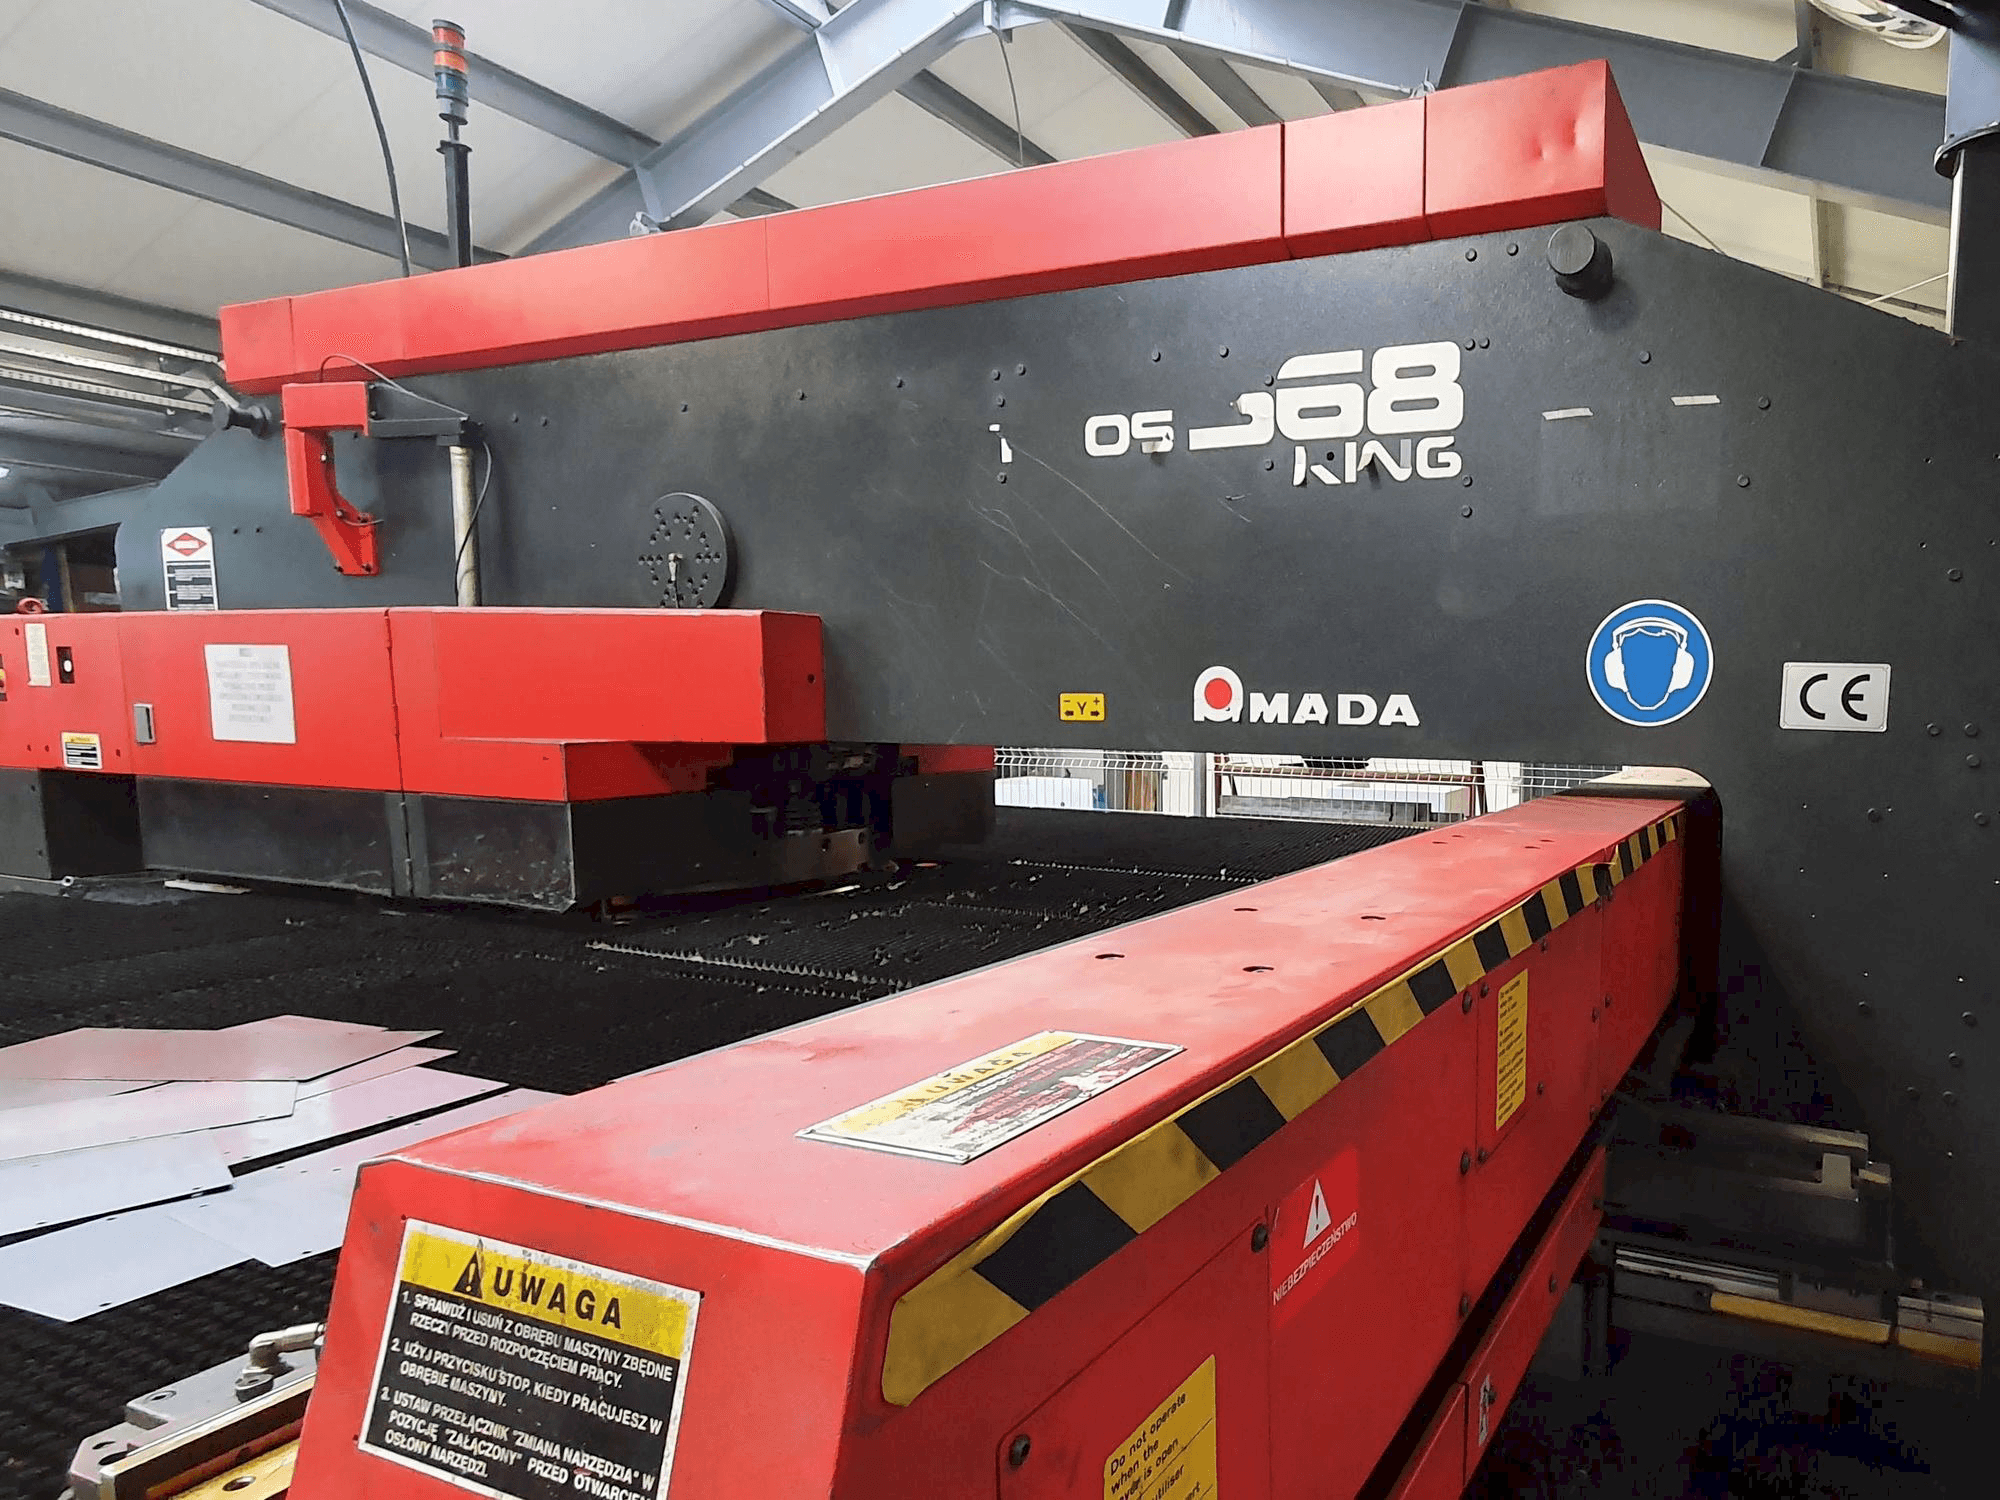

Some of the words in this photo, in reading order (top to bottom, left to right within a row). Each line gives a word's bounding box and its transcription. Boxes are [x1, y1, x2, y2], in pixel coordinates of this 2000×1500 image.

[1799, 673, 1871, 722] CE
[1272, 1211, 1358, 1306] NIEBEZPIECZEŃSTWO
[493, 1265, 622, 1330] UWAGA
[410, 1312, 453, 1336] RZECZY
[452, 1324, 489, 1348] PRZED
[489, 1336, 578, 1375] ROZPOCZĘCIEM
[579, 1361, 623, 1389] PRACY.
[472, 1309, 505, 1331] USUŃ
[504, 1319, 514, 1335] Z
[514, 1322, 563, 1348] OBRĘBU
[563, 1336, 622, 1366] MASZYNY
[622, 1353, 674, 1382] ZBĘDNE
[400, 1360, 450, 1388] OBRĘBIE
[449, 1377, 507, 1407] MASZYNY.
[403, 1341, 433, 1362] UŻYJ
[432, 1350, 498, 1382] PRZYCISKU
[497, 1369, 532, 1396] STOP,
[532, 1381, 571, 1405] KIEDY
[571, 1394, 648, 1431] PRACUJESZ
[649, 1417, 663, 1435] W
[384, 1429, 432, 1456] OSŁONY
[429, 1443, 489, 1478] NARZĘDZI.
[388, 1409, 440, 1442] POZYCJĘ
[527, 1457, 569, 1485] PRZED
[573, 1474, 651, 1500] OTWARCI
[393, 1390, 432, 1414] USTAW
[431, 1403, 510, 1441] PRZEŁĄCZNIK
[641, 1473, 656, 1491] W
[1110, 1455, 1126, 1476] Do
[1129, 1430, 1147, 1456] not
[1150, 1393, 1186, 1434] operate
[1110, 1460, 1139, 1494] when
[1143, 1439, 1159, 1461] the
[1155, 1438, 1179, 1467] open
